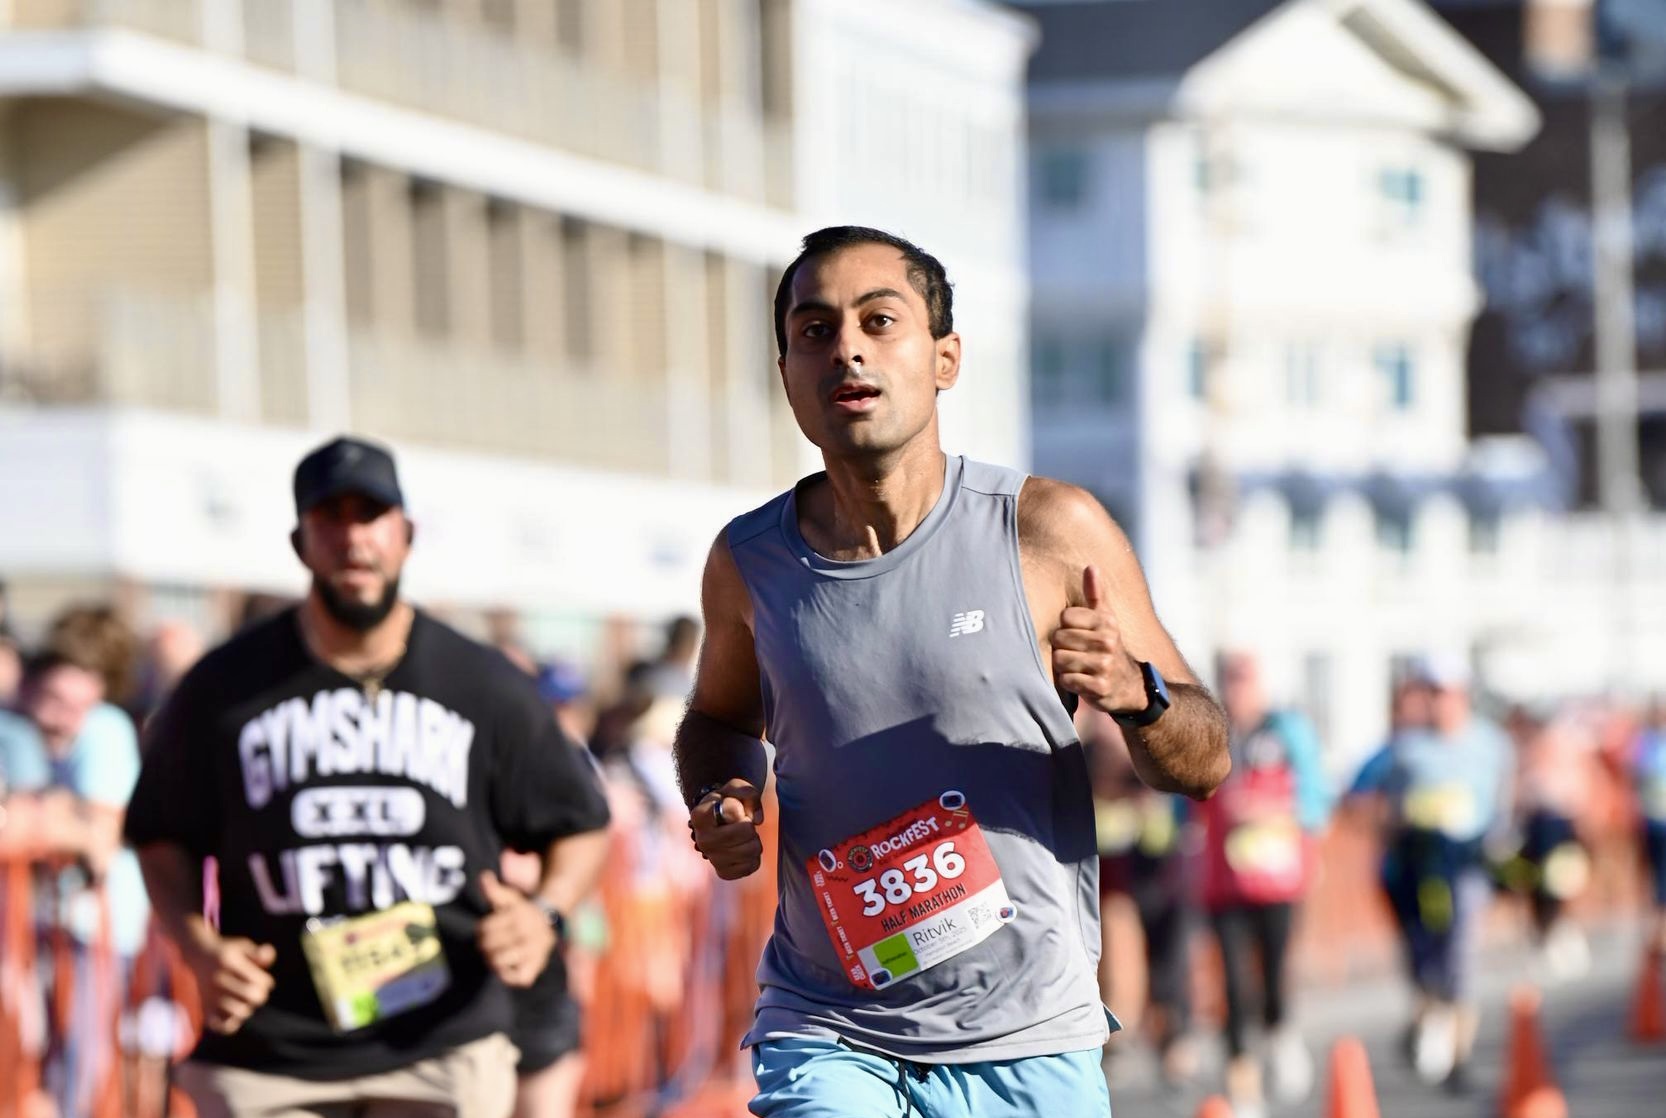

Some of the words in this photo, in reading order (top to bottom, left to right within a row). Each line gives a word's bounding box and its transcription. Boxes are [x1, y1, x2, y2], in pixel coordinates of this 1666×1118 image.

[238, 688, 475, 809] GYMSHARK
[313, 800, 393, 824] XXL
[870, 816, 940, 859] ROCKFEST
[247, 842, 467, 916] LIFTING
[853, 841, 967, 917] 3836
[881, 911, 908, 933] HALF
[909, 883, 967, 919] MARATHON
[912, 917, 957, 946] Ritvik
